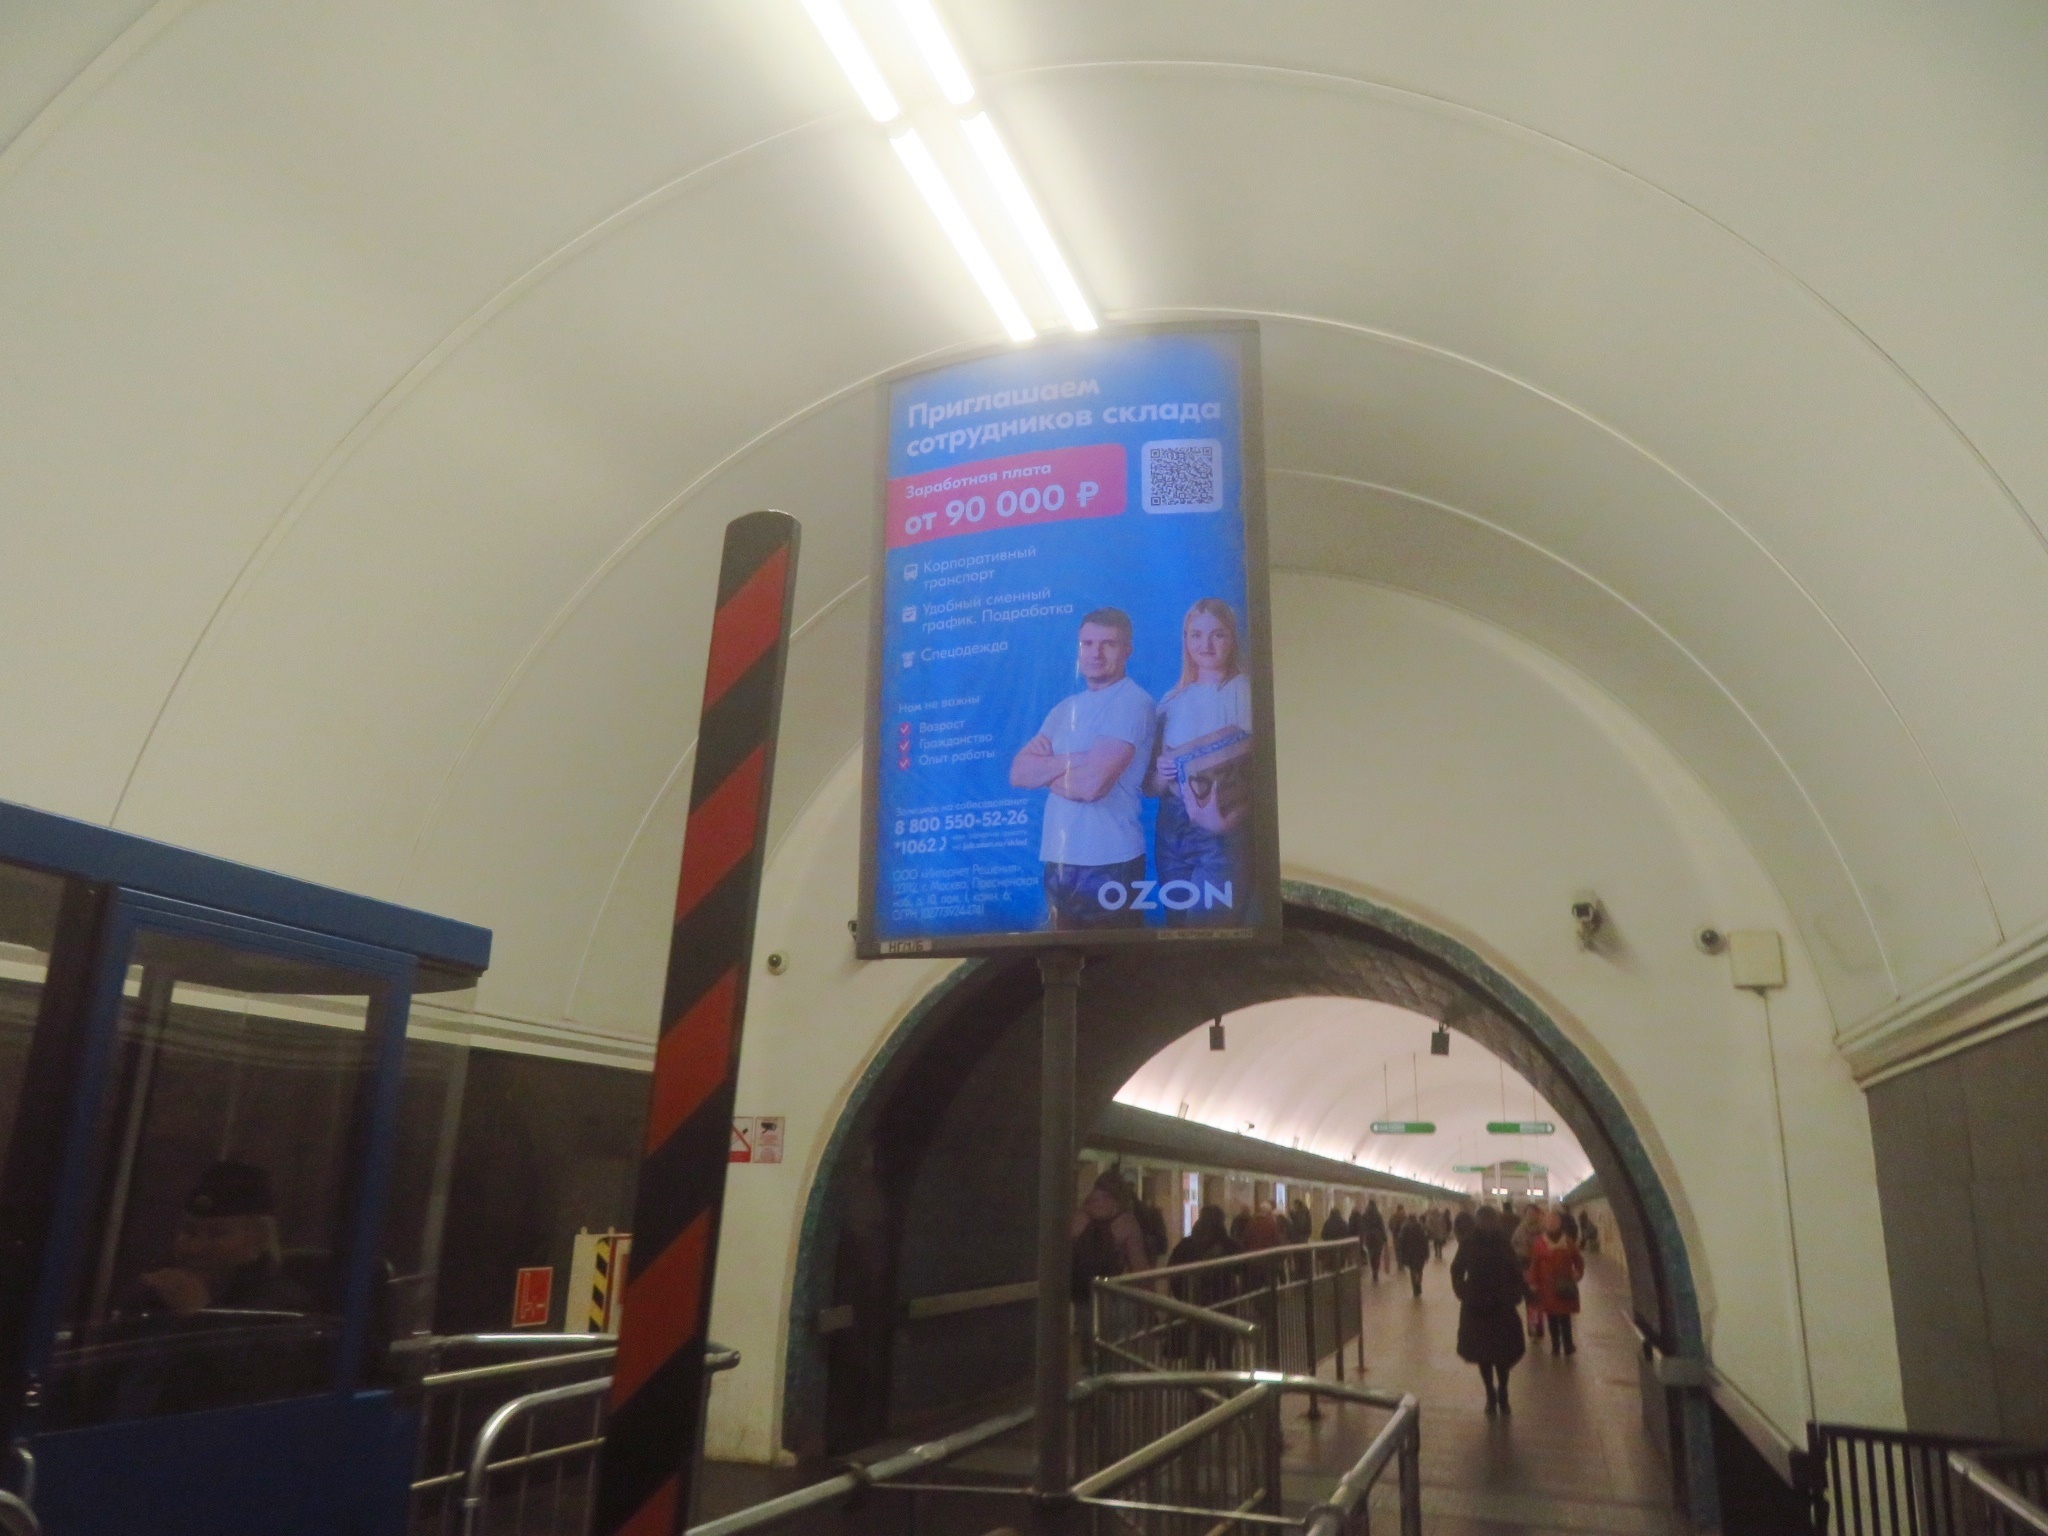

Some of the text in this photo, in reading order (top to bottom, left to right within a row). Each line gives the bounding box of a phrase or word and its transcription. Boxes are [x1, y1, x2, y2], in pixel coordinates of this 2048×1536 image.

[907, 376, 1100, 429] Приглашаем
[906, 401, 1222, 457] сотрудников склада
[905, 463, 1052, 500] Заработная плата
[904, 511, 937, 535] от
[945, 495, 987, 526] 90
[996, 484, 1065, 515] 000
[923, 546, 1036, 574] Корпоративный
[923, 569, 995, 591] транспорт
[922, 588, 1051, 617] Удобный сменный
[922, 602, 1074, 634] график. Подработка
[920, 640, 1009, 663] Спецодежда
[919, 719, 966, 734] Возраст
[919, 733, 993, 751] Гражданство
[918, 750, 996, 766] Опыт работы
[894, 809, 1028, 835] 8 800 550-52-26
[1097, 879, 1233, 911] OZON
